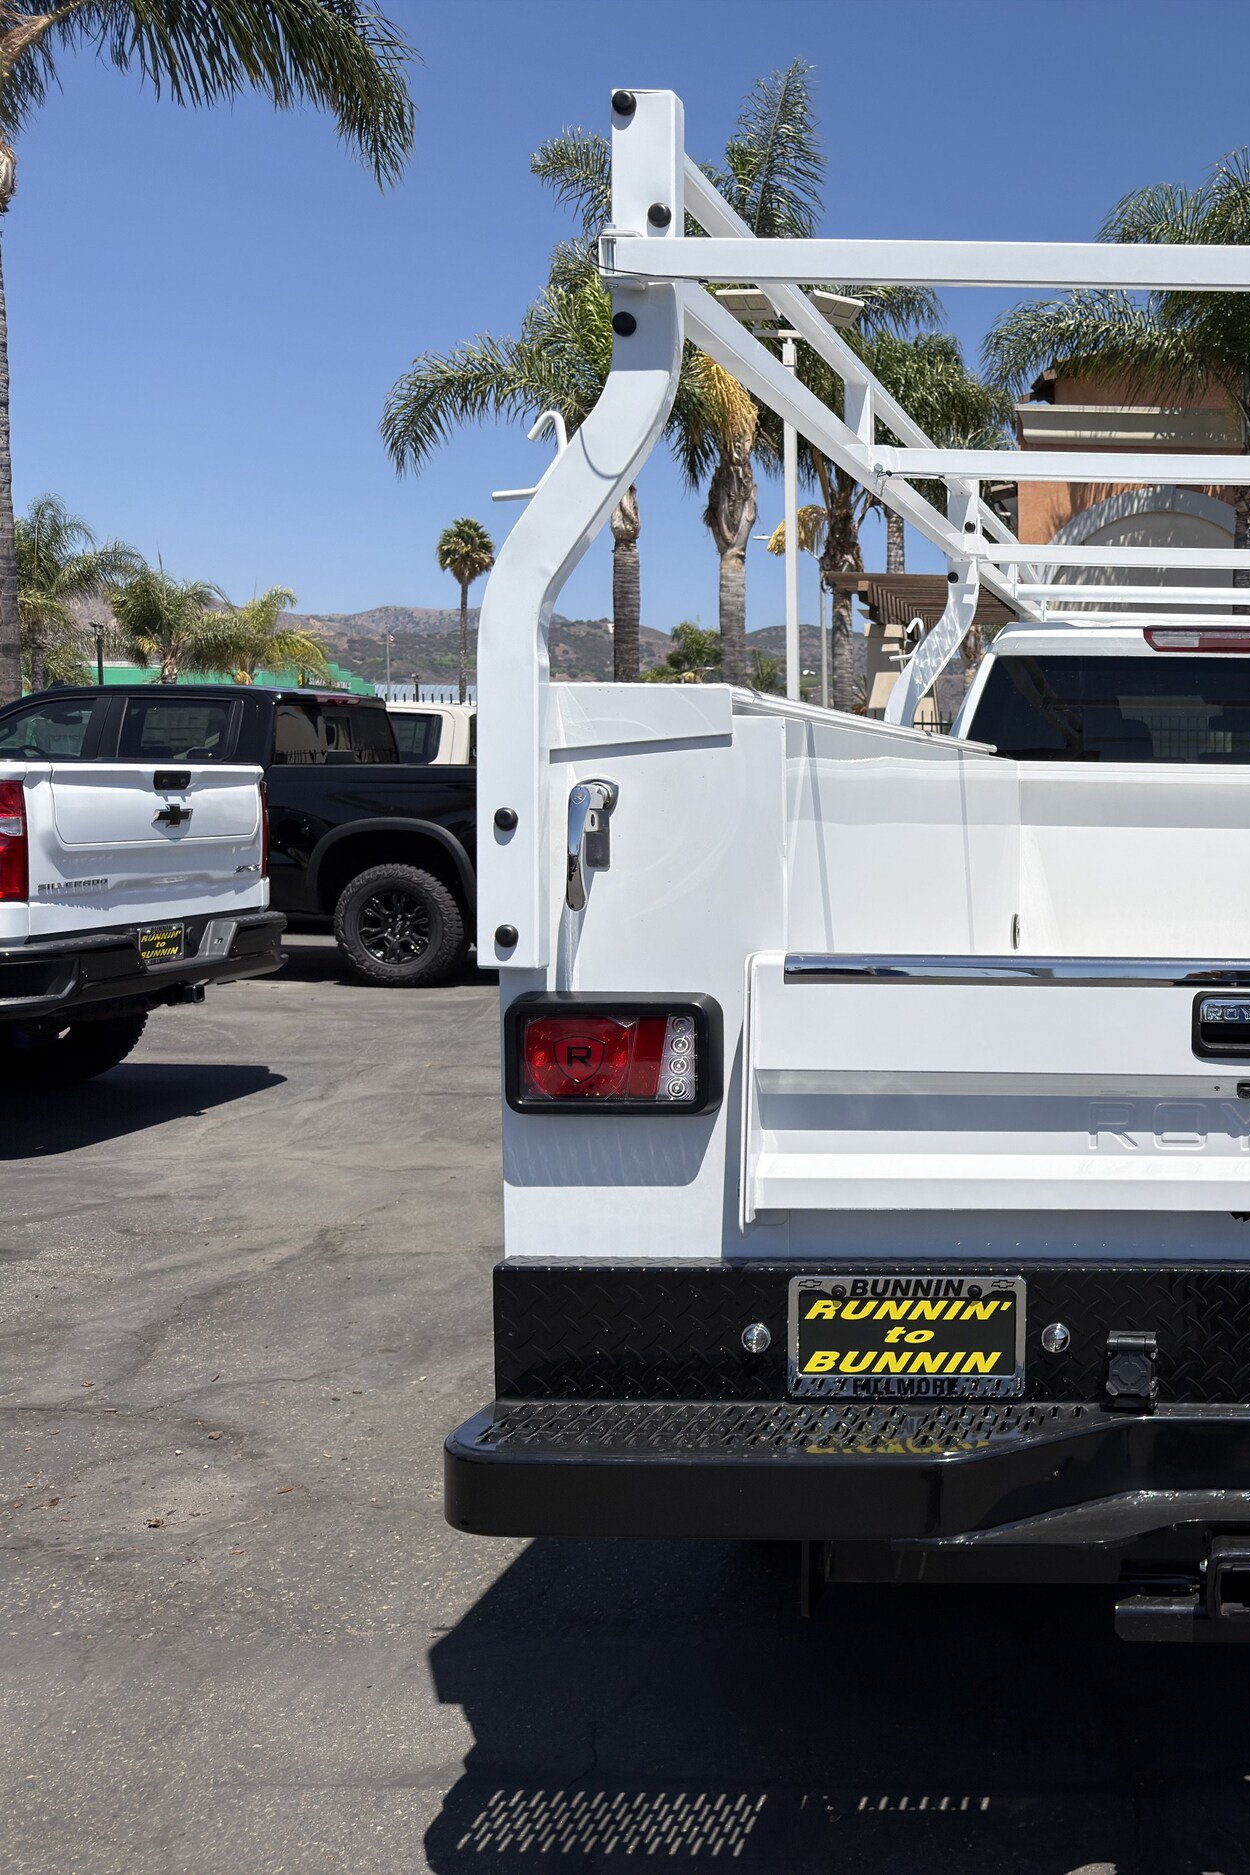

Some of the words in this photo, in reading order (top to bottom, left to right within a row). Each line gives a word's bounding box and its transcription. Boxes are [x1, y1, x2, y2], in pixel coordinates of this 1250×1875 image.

[38, 878, 108, 891] SILVERADO
[141, 930, 182, 942] RUNNIN'
[567, 1047, 592, 1067] R
[850, 1279, 964, 1297] BUNNIN
[804, 1300, 1012, 1320] RUNNIN'
[883, 1326, 935, 1344] to
[802, 1351, 1002, 1373] BUNNIN
[852, 1377, 960, 1396] FILLMORE
